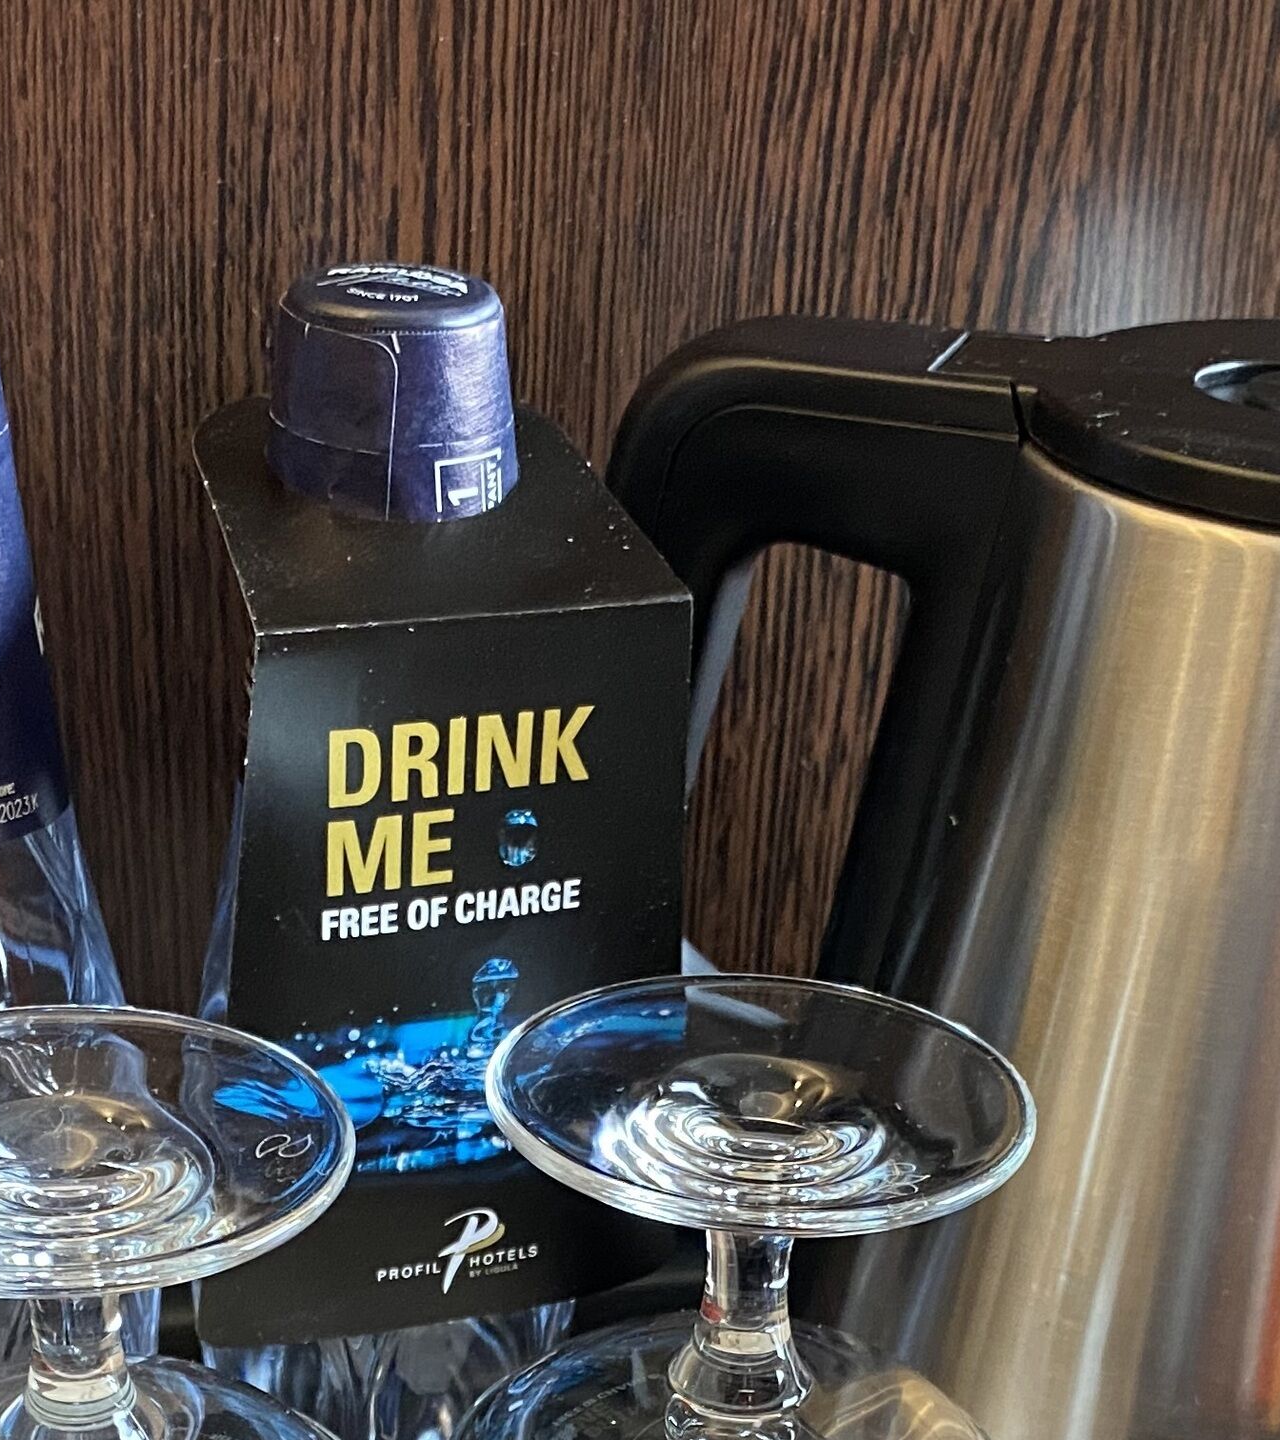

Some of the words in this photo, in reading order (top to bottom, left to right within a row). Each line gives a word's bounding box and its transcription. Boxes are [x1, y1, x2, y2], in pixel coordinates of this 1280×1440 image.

[347, 287, 386, 300] SINCE
[327, 705, 595, 808] DRINK
[326, 808, 455, 897] ME
[321, 902, 399, 941] FREE
[407, 896, 449, 932] OF
[455, 879, 582, 924] CHARGE
[376, 1262, 441, 1282] PROFIL
[469, 1244, 539, 1268] HOTELS
